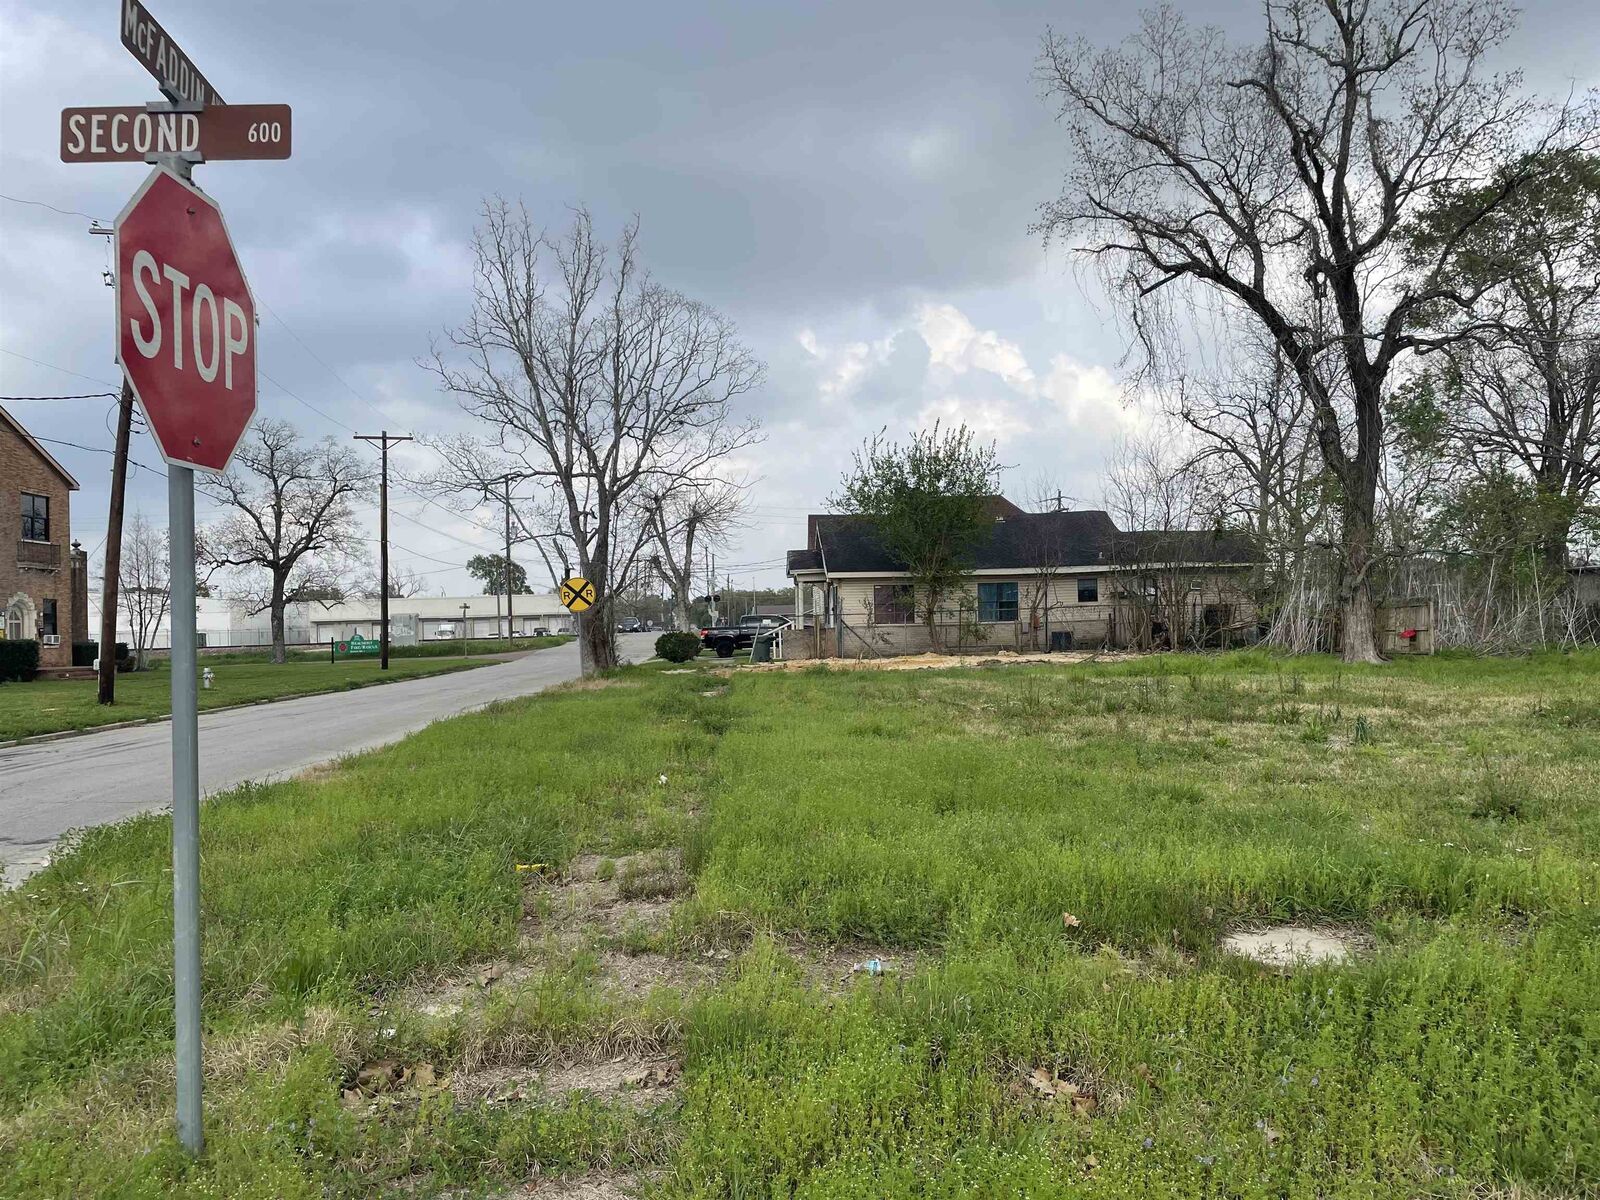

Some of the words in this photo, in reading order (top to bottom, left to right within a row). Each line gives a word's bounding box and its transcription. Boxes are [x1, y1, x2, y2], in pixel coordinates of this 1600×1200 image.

[67, 113, 200, 154] SECOND
[248, 122, 281, 143] 600
[130, 249, 248, 391] STOP
[563, 591, 571, 600] R
[586, 589, 593, 598] R
